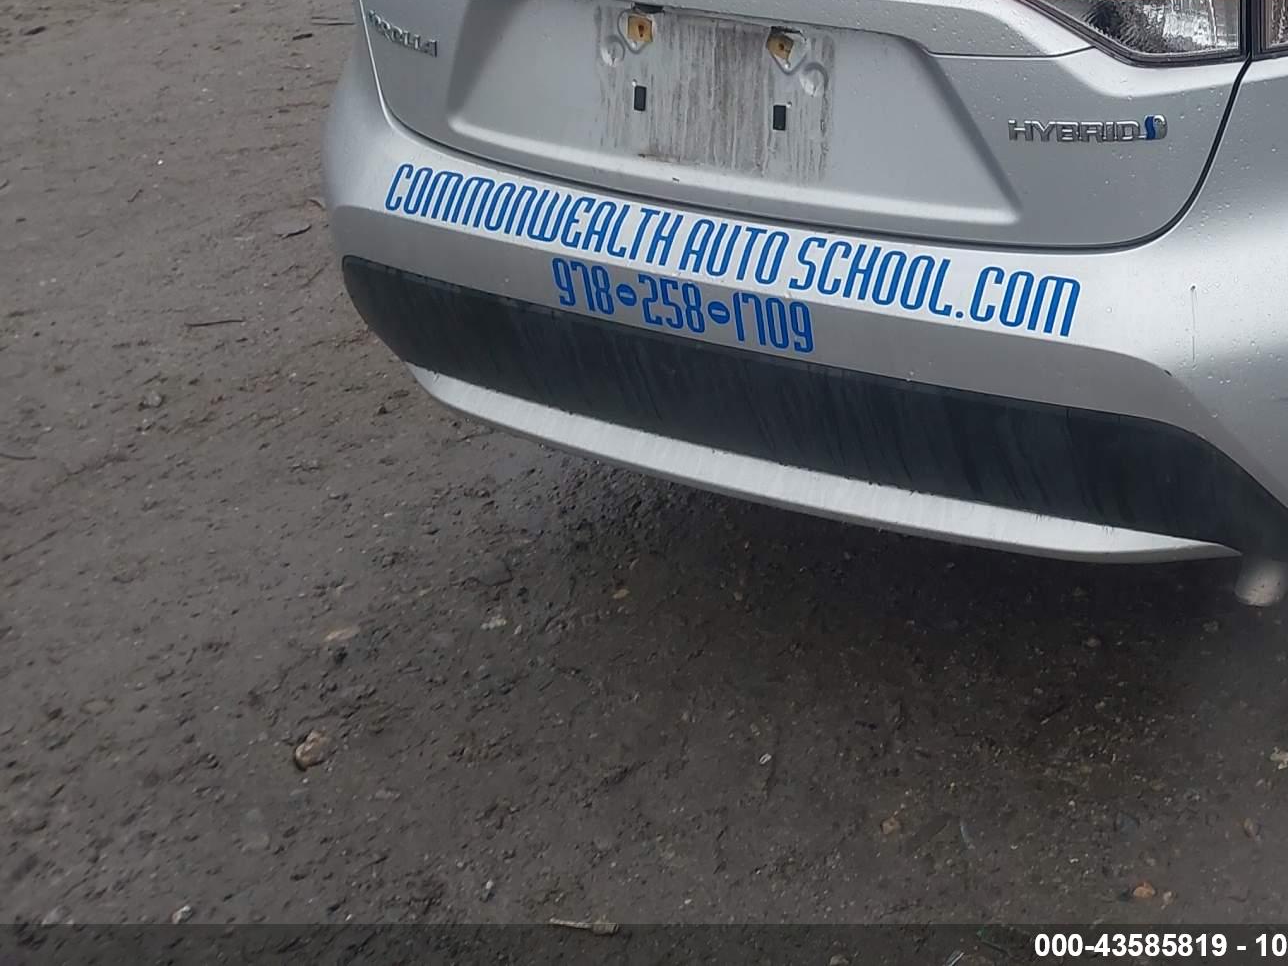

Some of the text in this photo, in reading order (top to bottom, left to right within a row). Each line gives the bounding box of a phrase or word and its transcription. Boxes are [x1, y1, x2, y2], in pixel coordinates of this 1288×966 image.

[1008, 119, 1141, 143] HYBRID
[384, 163, 1082, 338] COMMONWEALTH AUTO SCHOOL.COM
